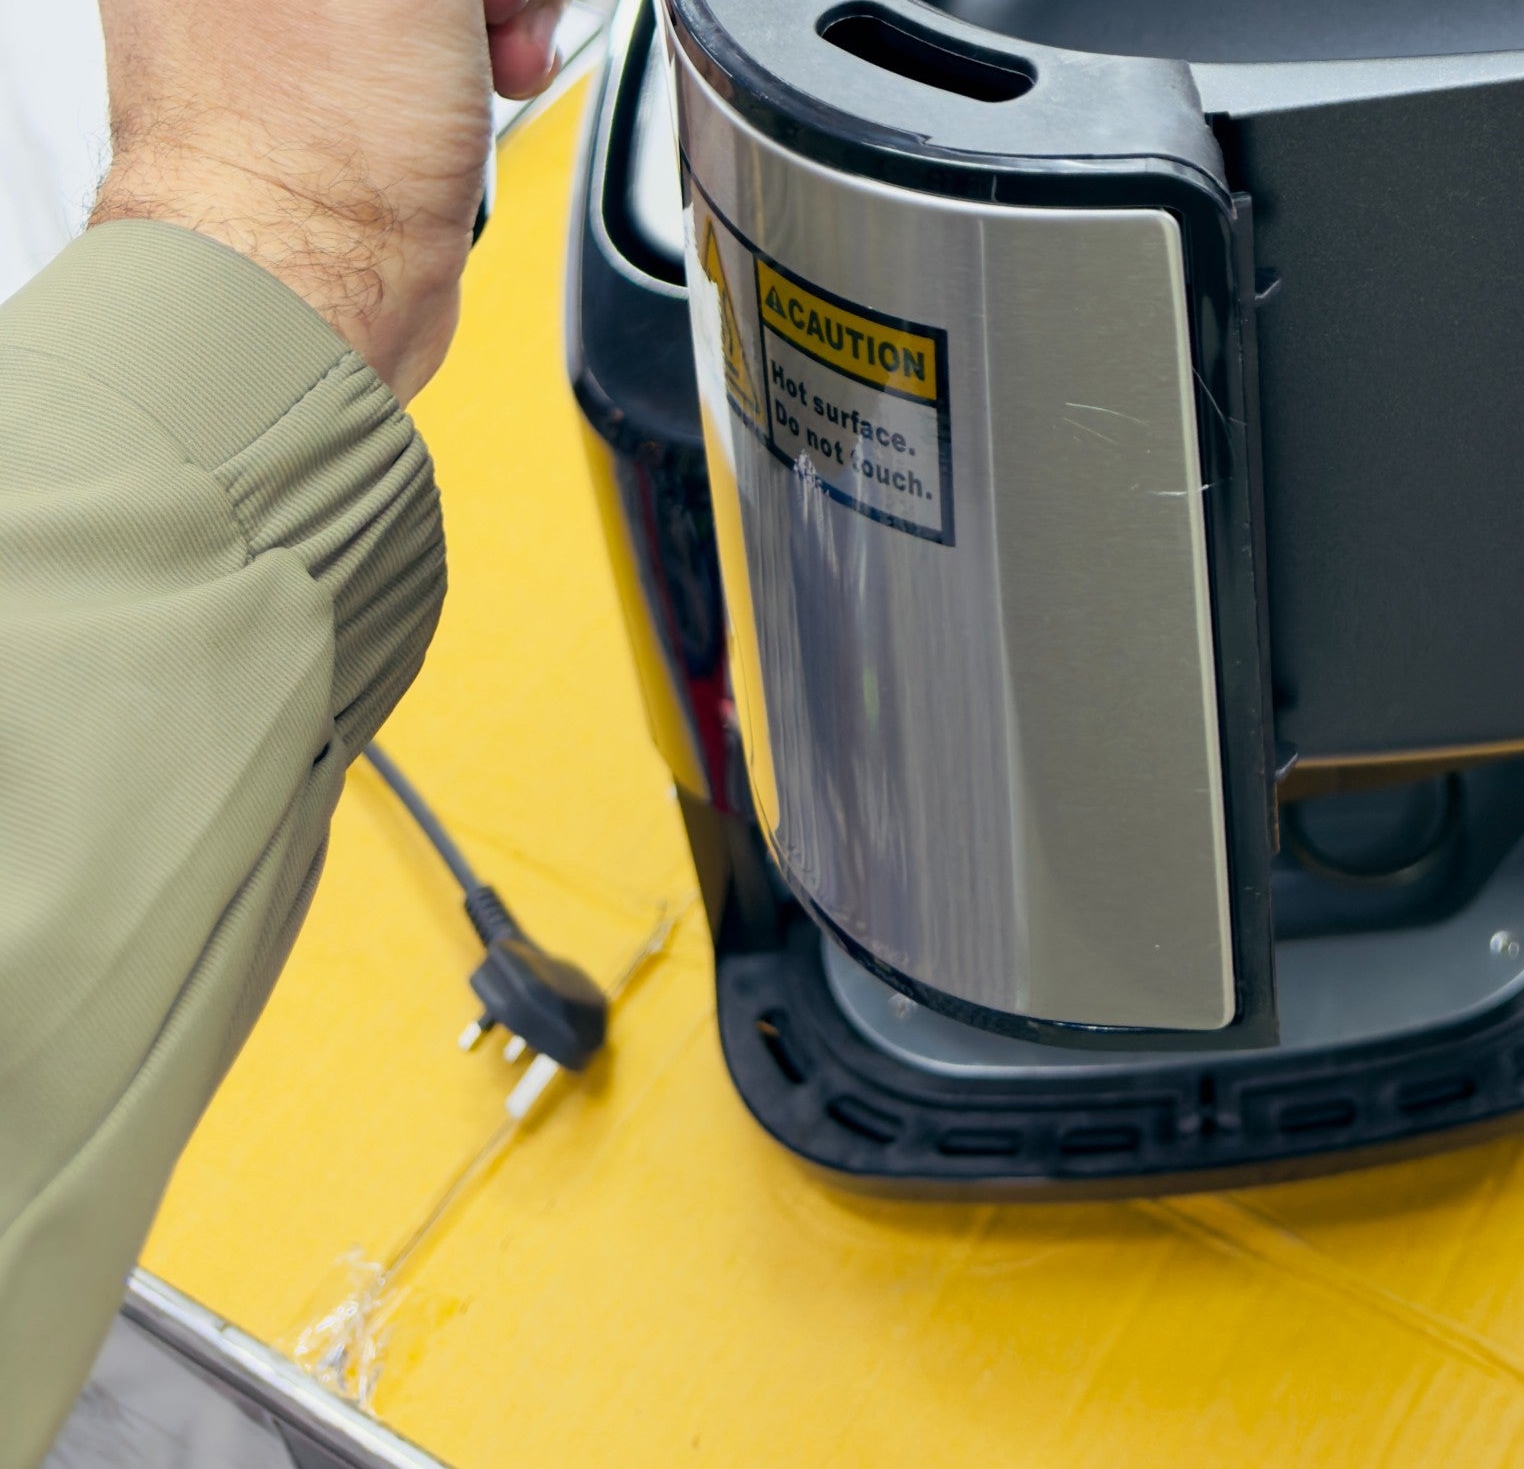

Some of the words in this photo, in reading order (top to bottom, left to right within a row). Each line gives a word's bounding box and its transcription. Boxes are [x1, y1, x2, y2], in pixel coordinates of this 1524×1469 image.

[788, 297, 926, 382] CAUTION
[771, 360, 808, 405] Hot
[813, 395, 916, 456] surface.
[775, 400, 799, 436] Do
[807, 426, 845, 465] not
